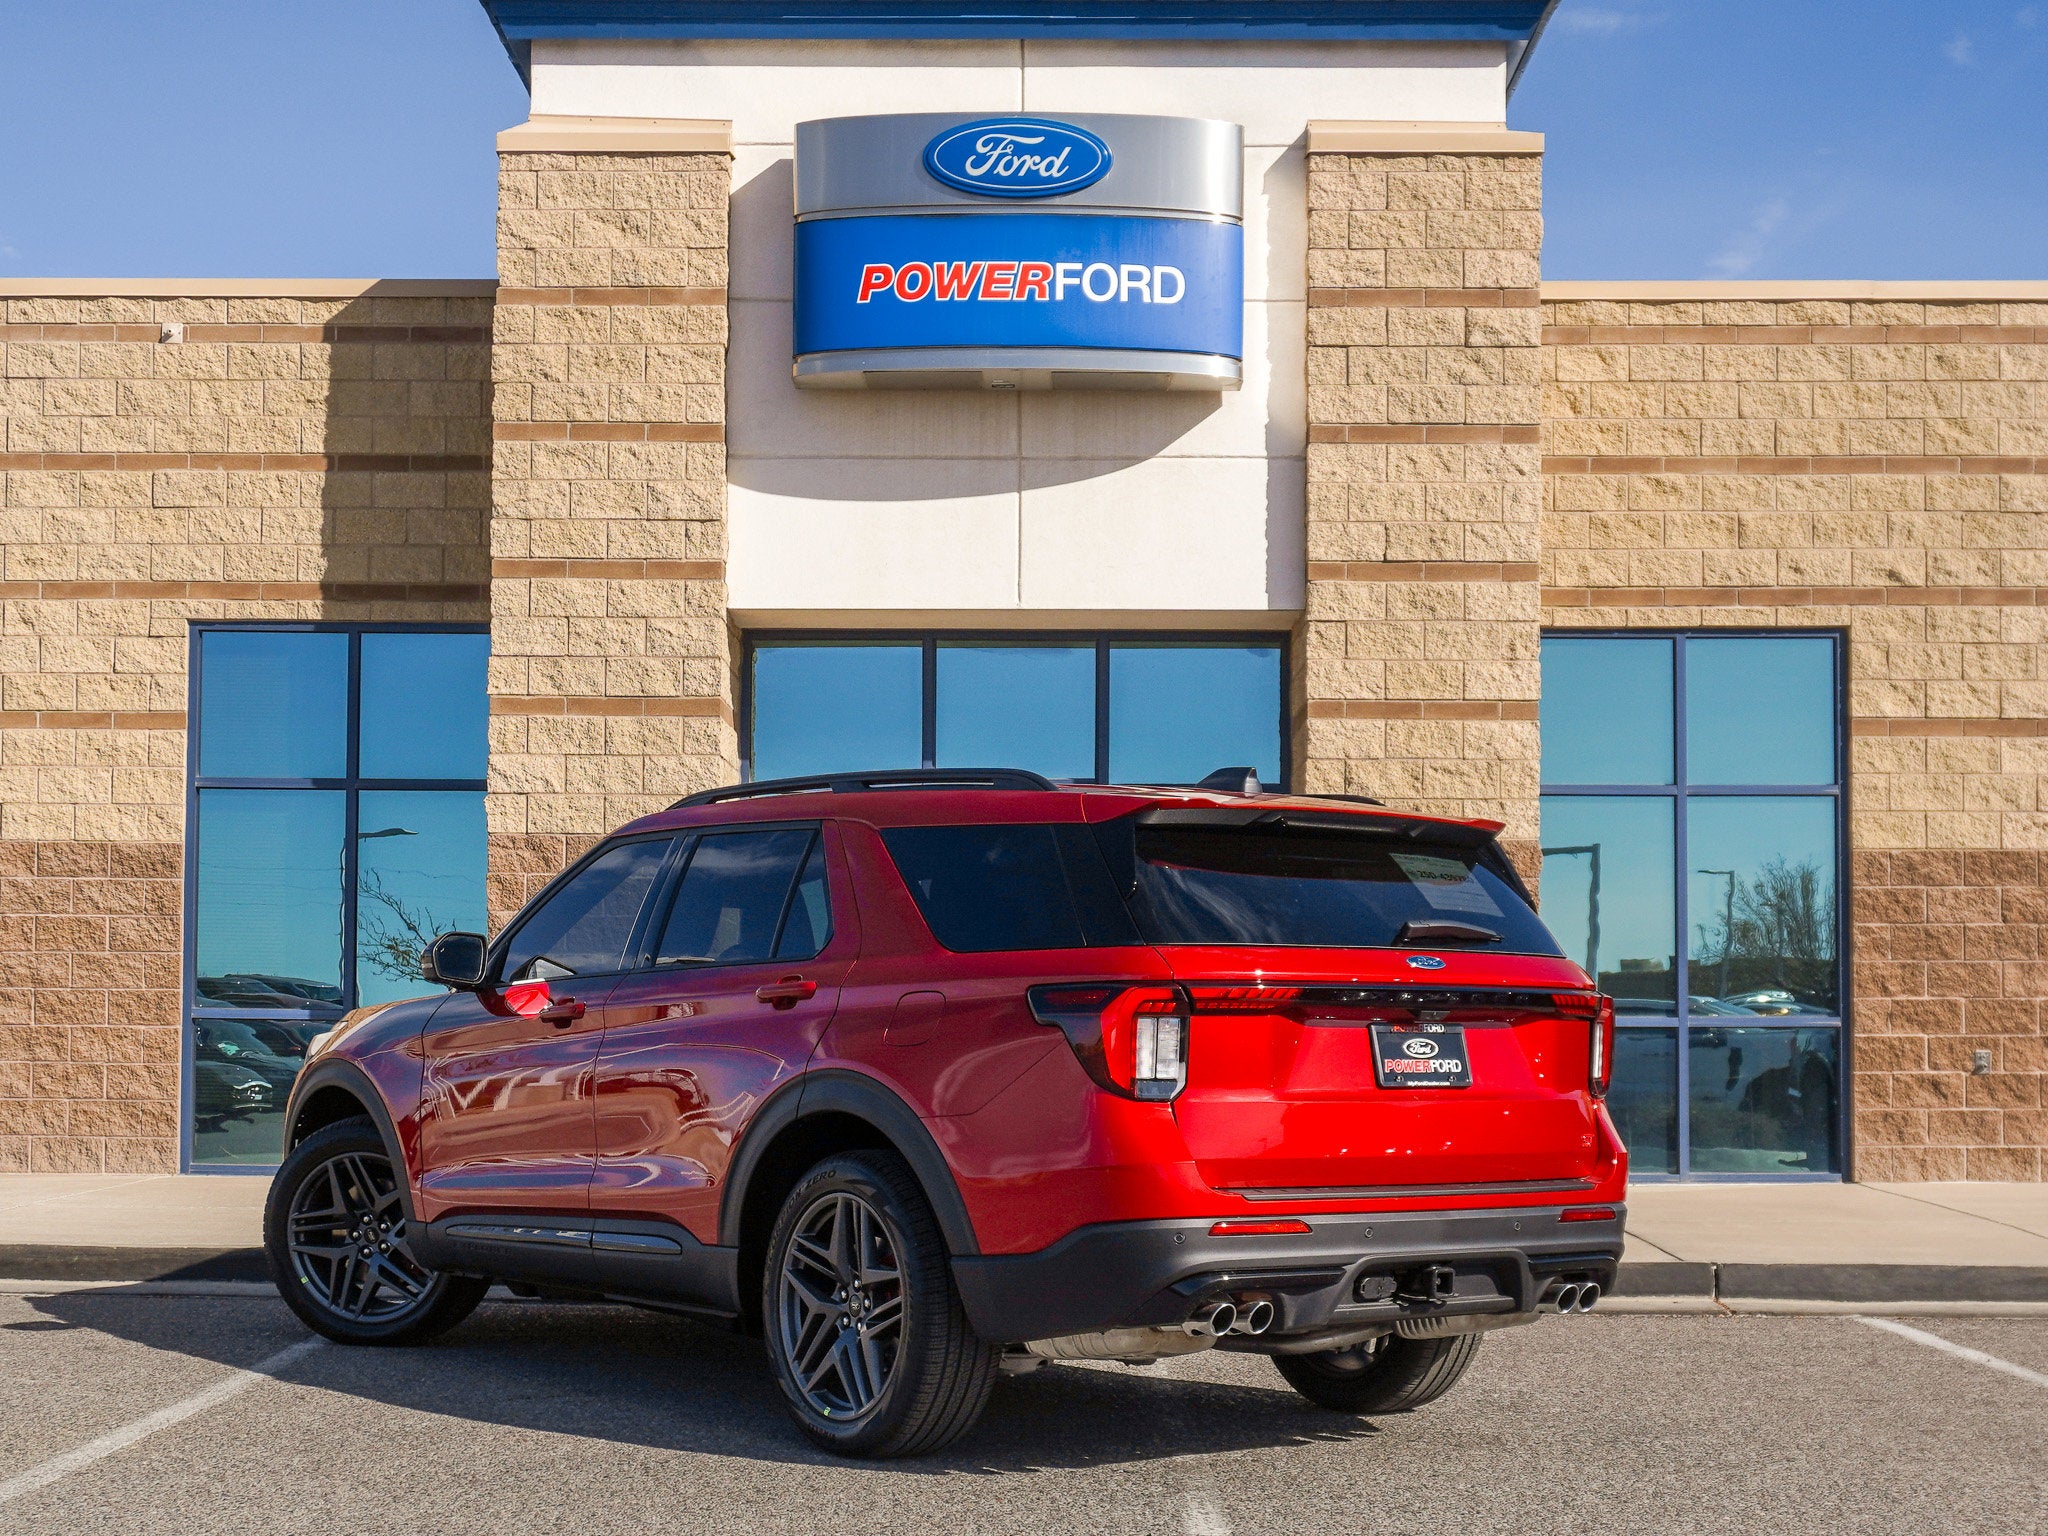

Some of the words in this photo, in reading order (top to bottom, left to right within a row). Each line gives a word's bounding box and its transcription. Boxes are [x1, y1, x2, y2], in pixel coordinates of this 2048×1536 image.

[964, 132, 1072, 178] Ford
[856, 260, 1187, 305] POWERFORD
[1408, 1040, 1432, 1054] Ford
[1384, 1059, 1462, 1073] POWERFORD
